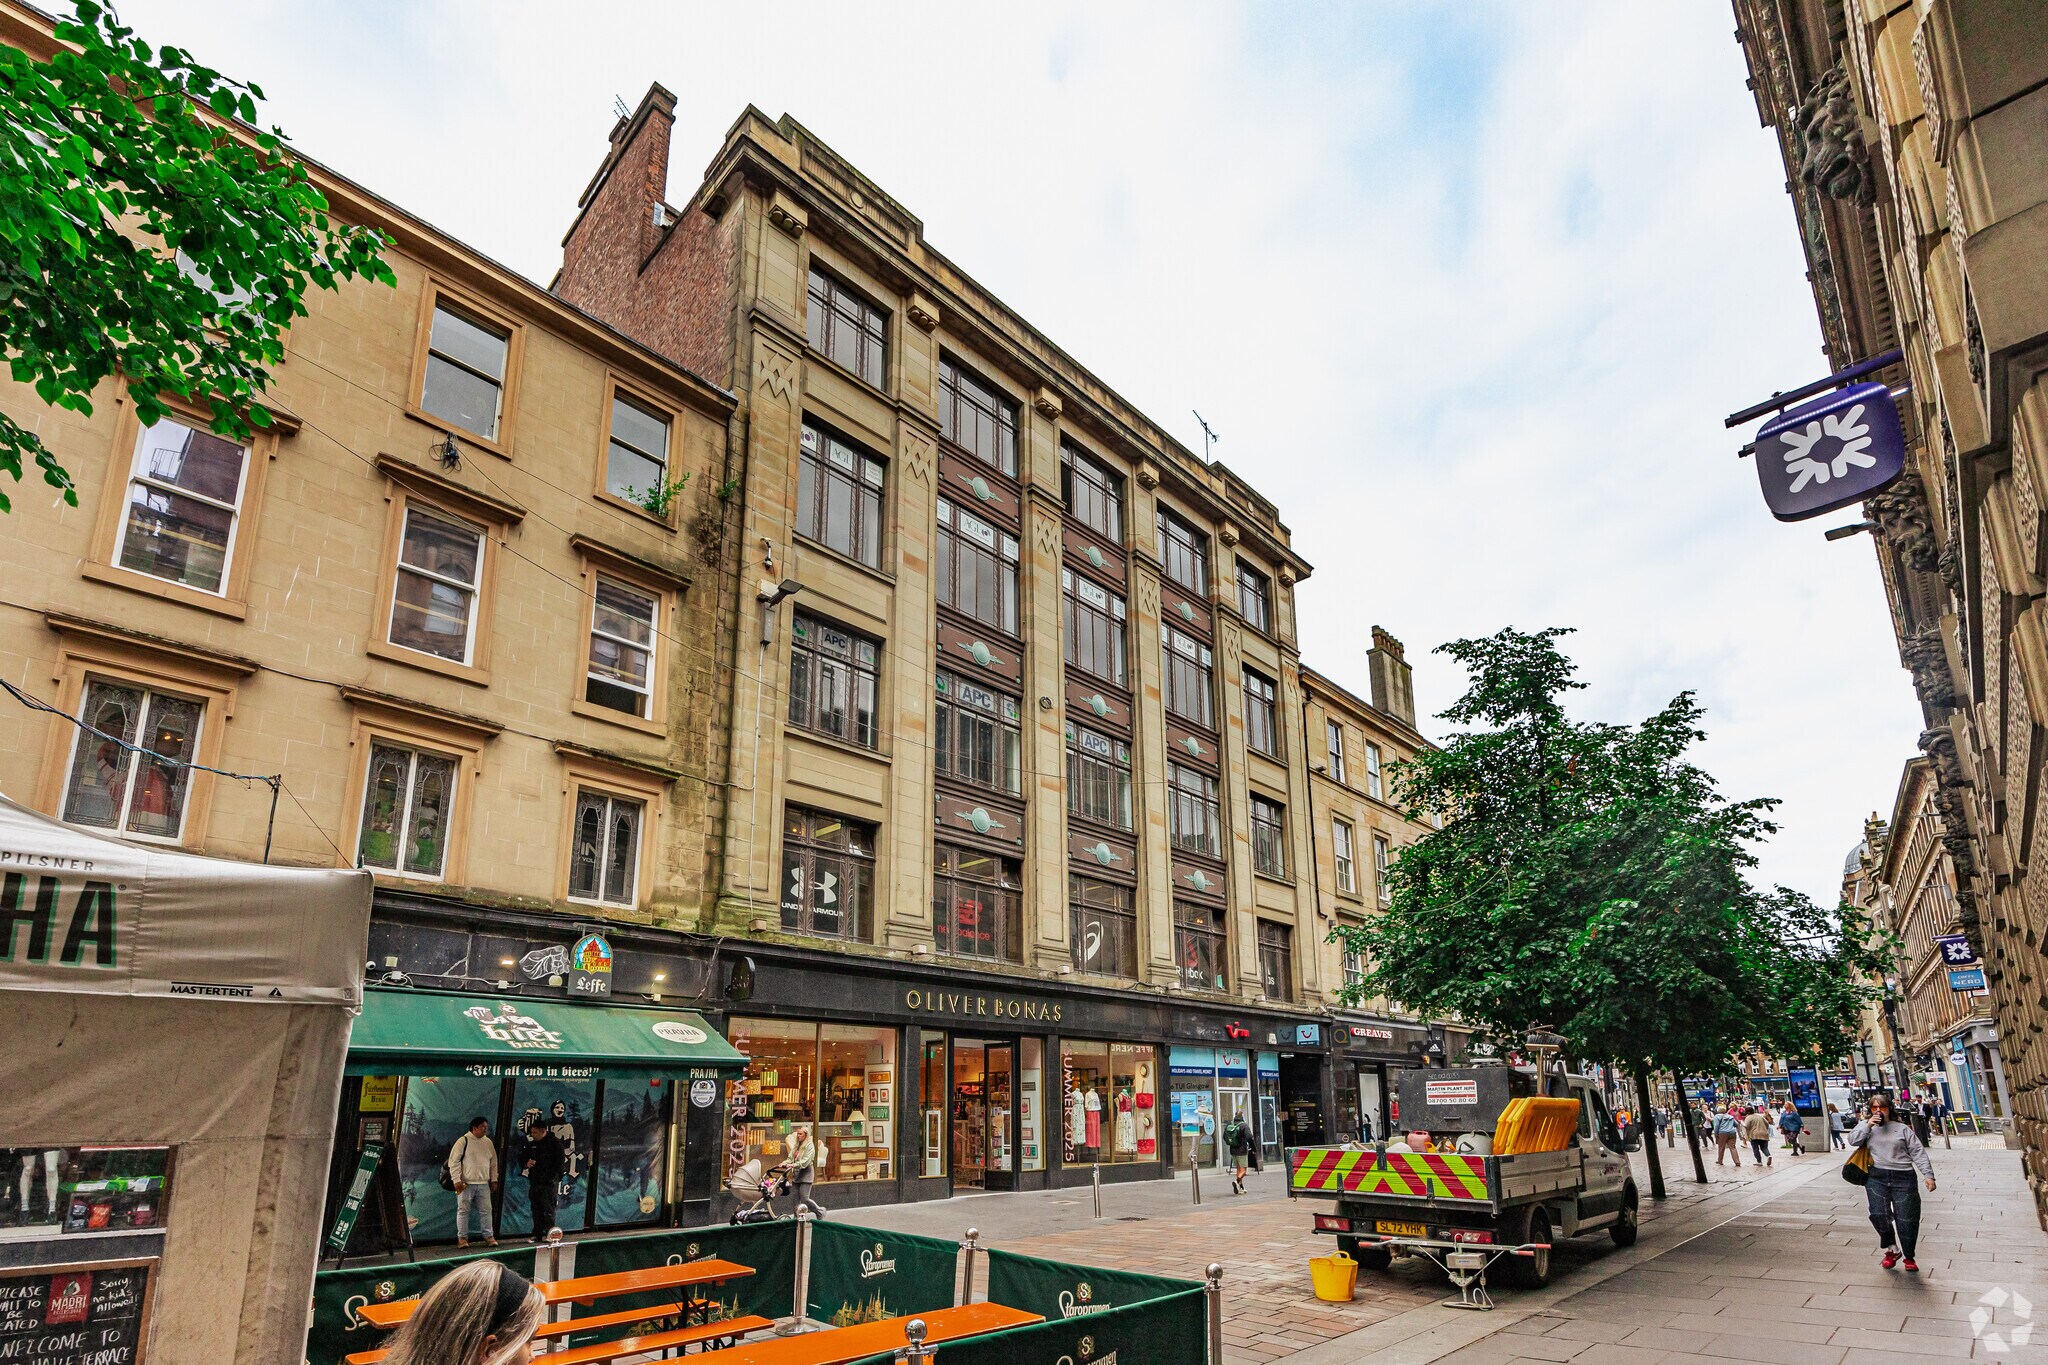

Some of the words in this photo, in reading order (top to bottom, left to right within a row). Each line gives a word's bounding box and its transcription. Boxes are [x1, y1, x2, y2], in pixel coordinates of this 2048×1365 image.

[824, 633, 846, 649] APC
[962, 686, 991, 708] APC
[1084, 734, 1107, 754] APC
[1, 852, 95, 872] PILSNER
[781, 901, 804, 912] UND
[1175, 965, 1204, 980] Rbok
[170, 985, 253, 997] MASTERTENT
[576, 976, 607, 993] Leffe
[906, 989, 986, 1017] OLIVER
[993, 998, 1063, 1022] BONAS
[479, 1023, 564, 1043] bier
[657, 1028, 700, 1037] PRAVHA
[1351, 1027, 1393, 1039] GREAVES
[504, 1065, 520, 1076] all
[523, 1066, 543, 1077] end
[546, 1066, 558, 1077] in
[1062, 1048, 1075, 1117] SUMMER
[1064, 1121, 1076, 1162] 2025
[1380, 1222, 1403, 1233] SL72
[1405, 1224, 1422, 1234] YHK
[0, 1285, 44, 1300] PLEASE
[92, 1296, 105, 1304] no
[108, 1288, 133, 1300] kids
[28, 1299, 42, 1310] TO
[96, 1294, 139, 1313] Allowed!
[6, 1310, 24, 1319] BE
[100, 1327, 121, 1347] TO
[79, 1347, 131, 1365] TERRACE
